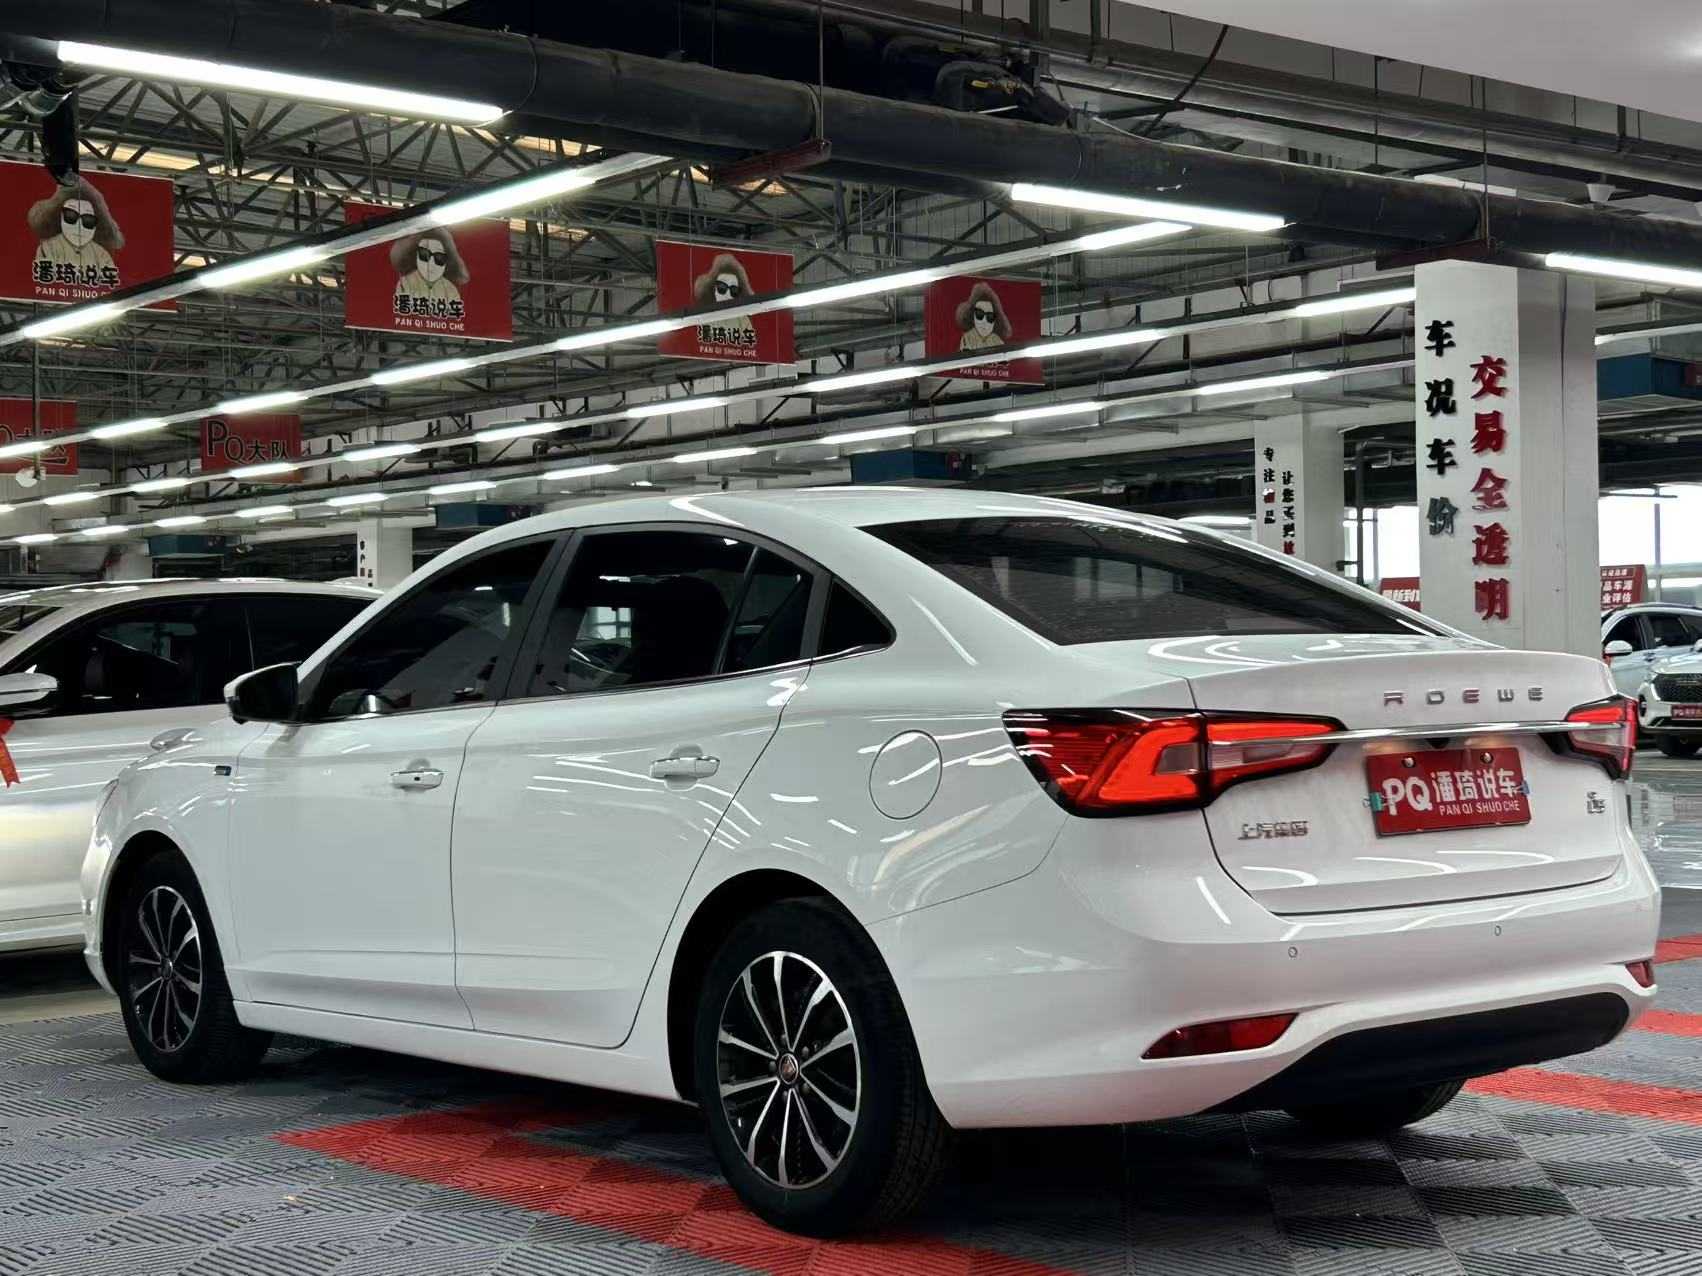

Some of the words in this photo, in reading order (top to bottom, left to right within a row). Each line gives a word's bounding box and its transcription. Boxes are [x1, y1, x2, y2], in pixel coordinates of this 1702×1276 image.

[33, 260, 120, 290] 潘琦说车
[35, 287, 56, 296] PAN
[58, 289, 69, 297] QI
[72, 290, 98, 299] SHUO
[394, 294, 464, 320] 潘琦说车
[395, 318, 412, 326] PAN
[414, 319, 423, 327] QI
[425, 320, 447, 329] SHUO
[449, 323, 465, 331] CHE
[700, 345, 714, 353] PAN
[1424, 319, 1459, 537] 车况车价
[1383, 687, 1544, 706] ROEWE
[1382, 776, 1433, 815] PQ
[1431, 768, 1517, 803] 潘琦说车
[1439, 804, 1461, 816] PAN
[1462, 804, 1473, 815] QI
[1476, 801, 1502, 813] SHUO
[1503, 800, 1520, 811] CHE
